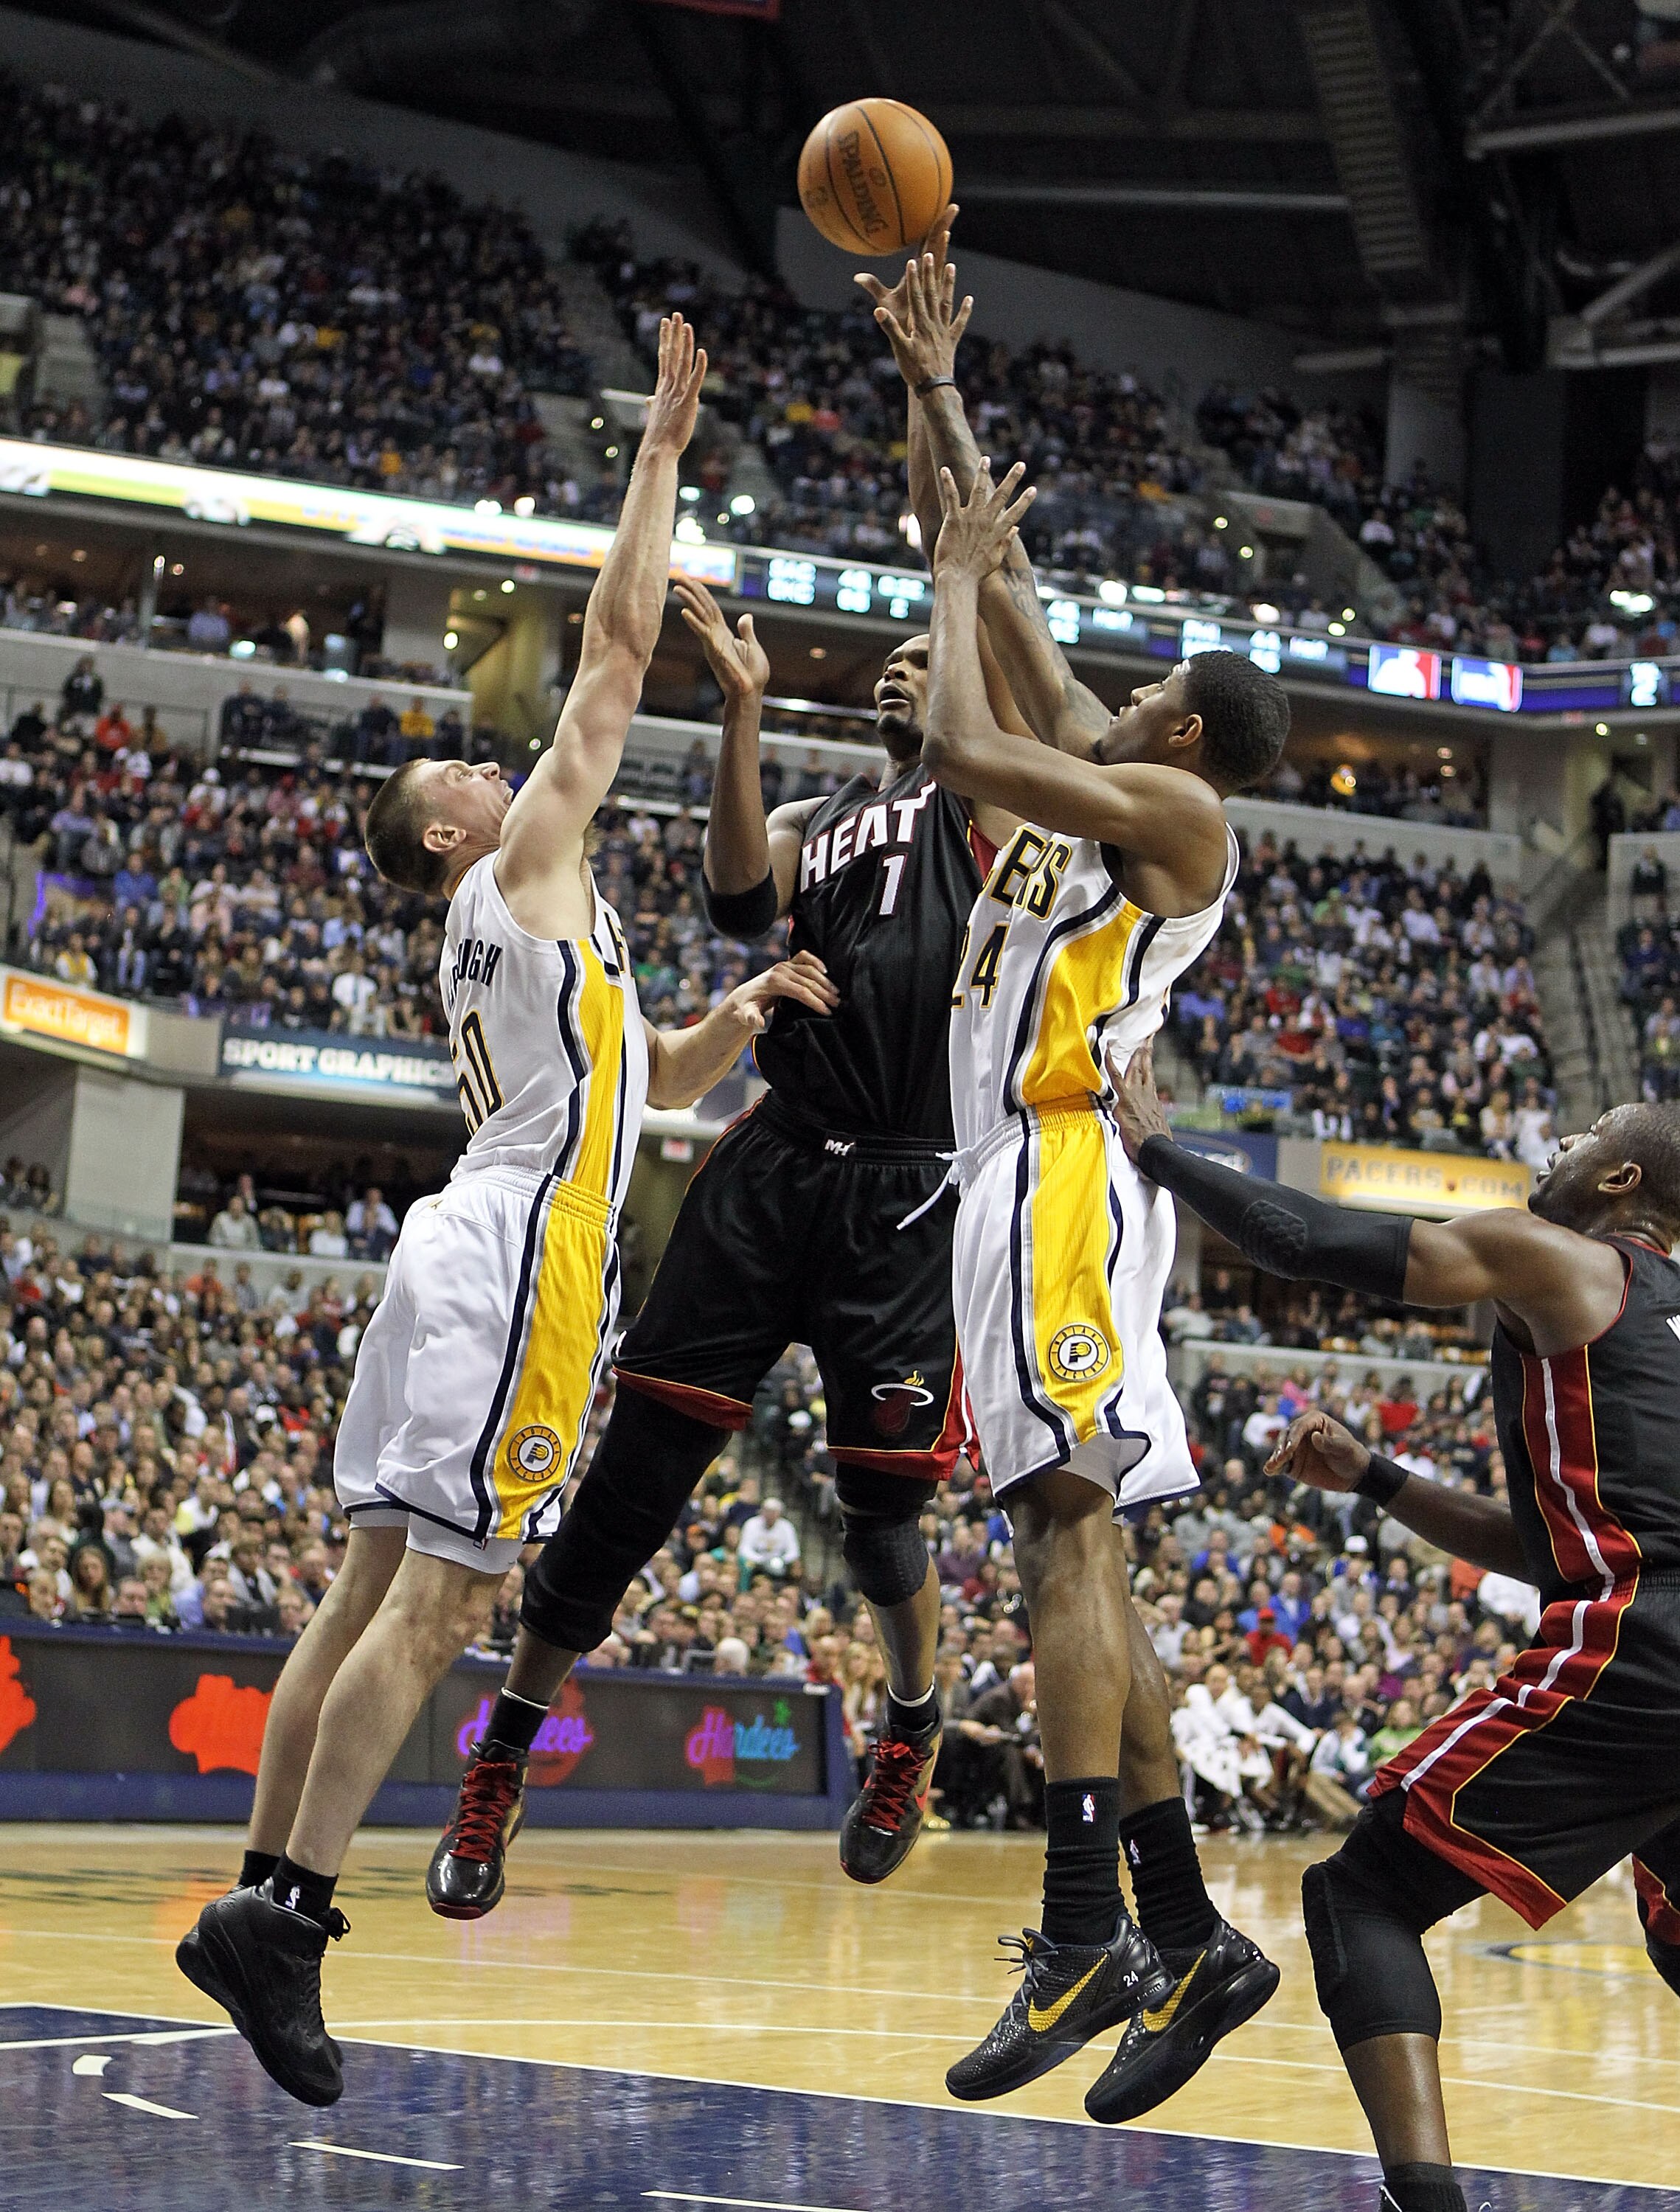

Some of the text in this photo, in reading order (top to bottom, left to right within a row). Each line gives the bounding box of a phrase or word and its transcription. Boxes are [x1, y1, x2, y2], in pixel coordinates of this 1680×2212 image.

[800, 779, 937, 894] HEAT
[878, 852, 908, 917] 1
[223, 1037, 317, 1073] SPORT
[1122, 1970, 1139, 1988] 24
